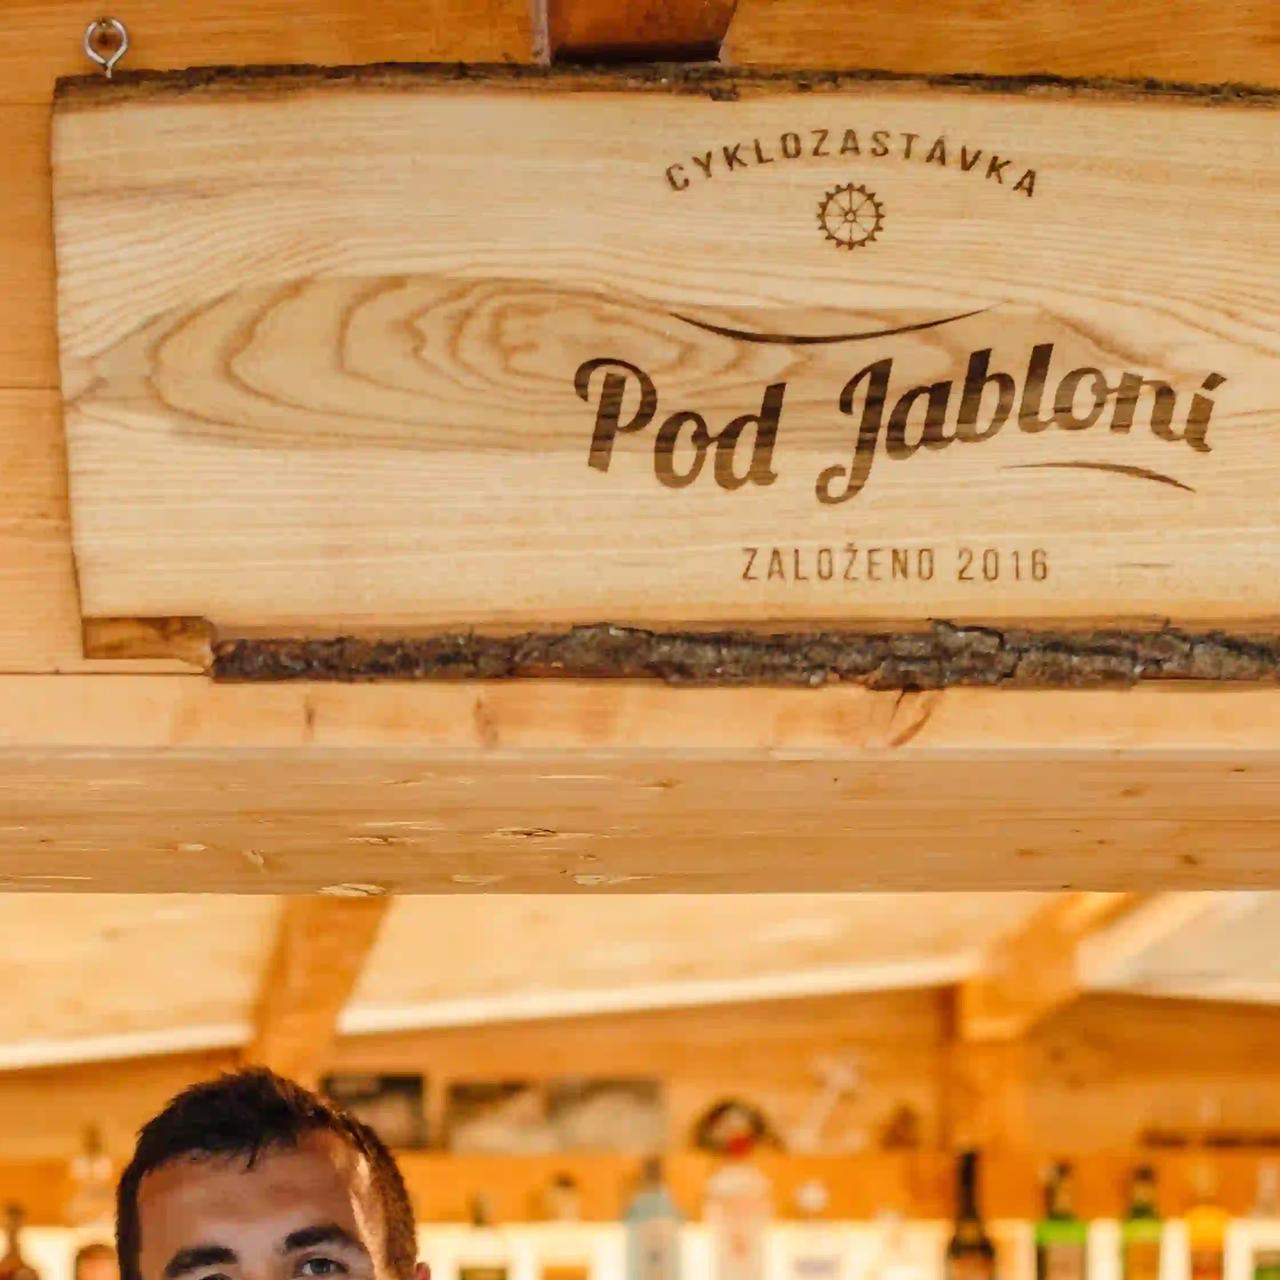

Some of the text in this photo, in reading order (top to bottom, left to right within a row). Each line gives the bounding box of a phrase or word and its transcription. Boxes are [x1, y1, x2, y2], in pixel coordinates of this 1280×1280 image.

[665, 128, 1039, 198] CYKLOZASTÁVKA
[574, 342, 1228, 504] Pod Jabloní
[742, 542, 1050, 582] ZALOŽENO 2016
